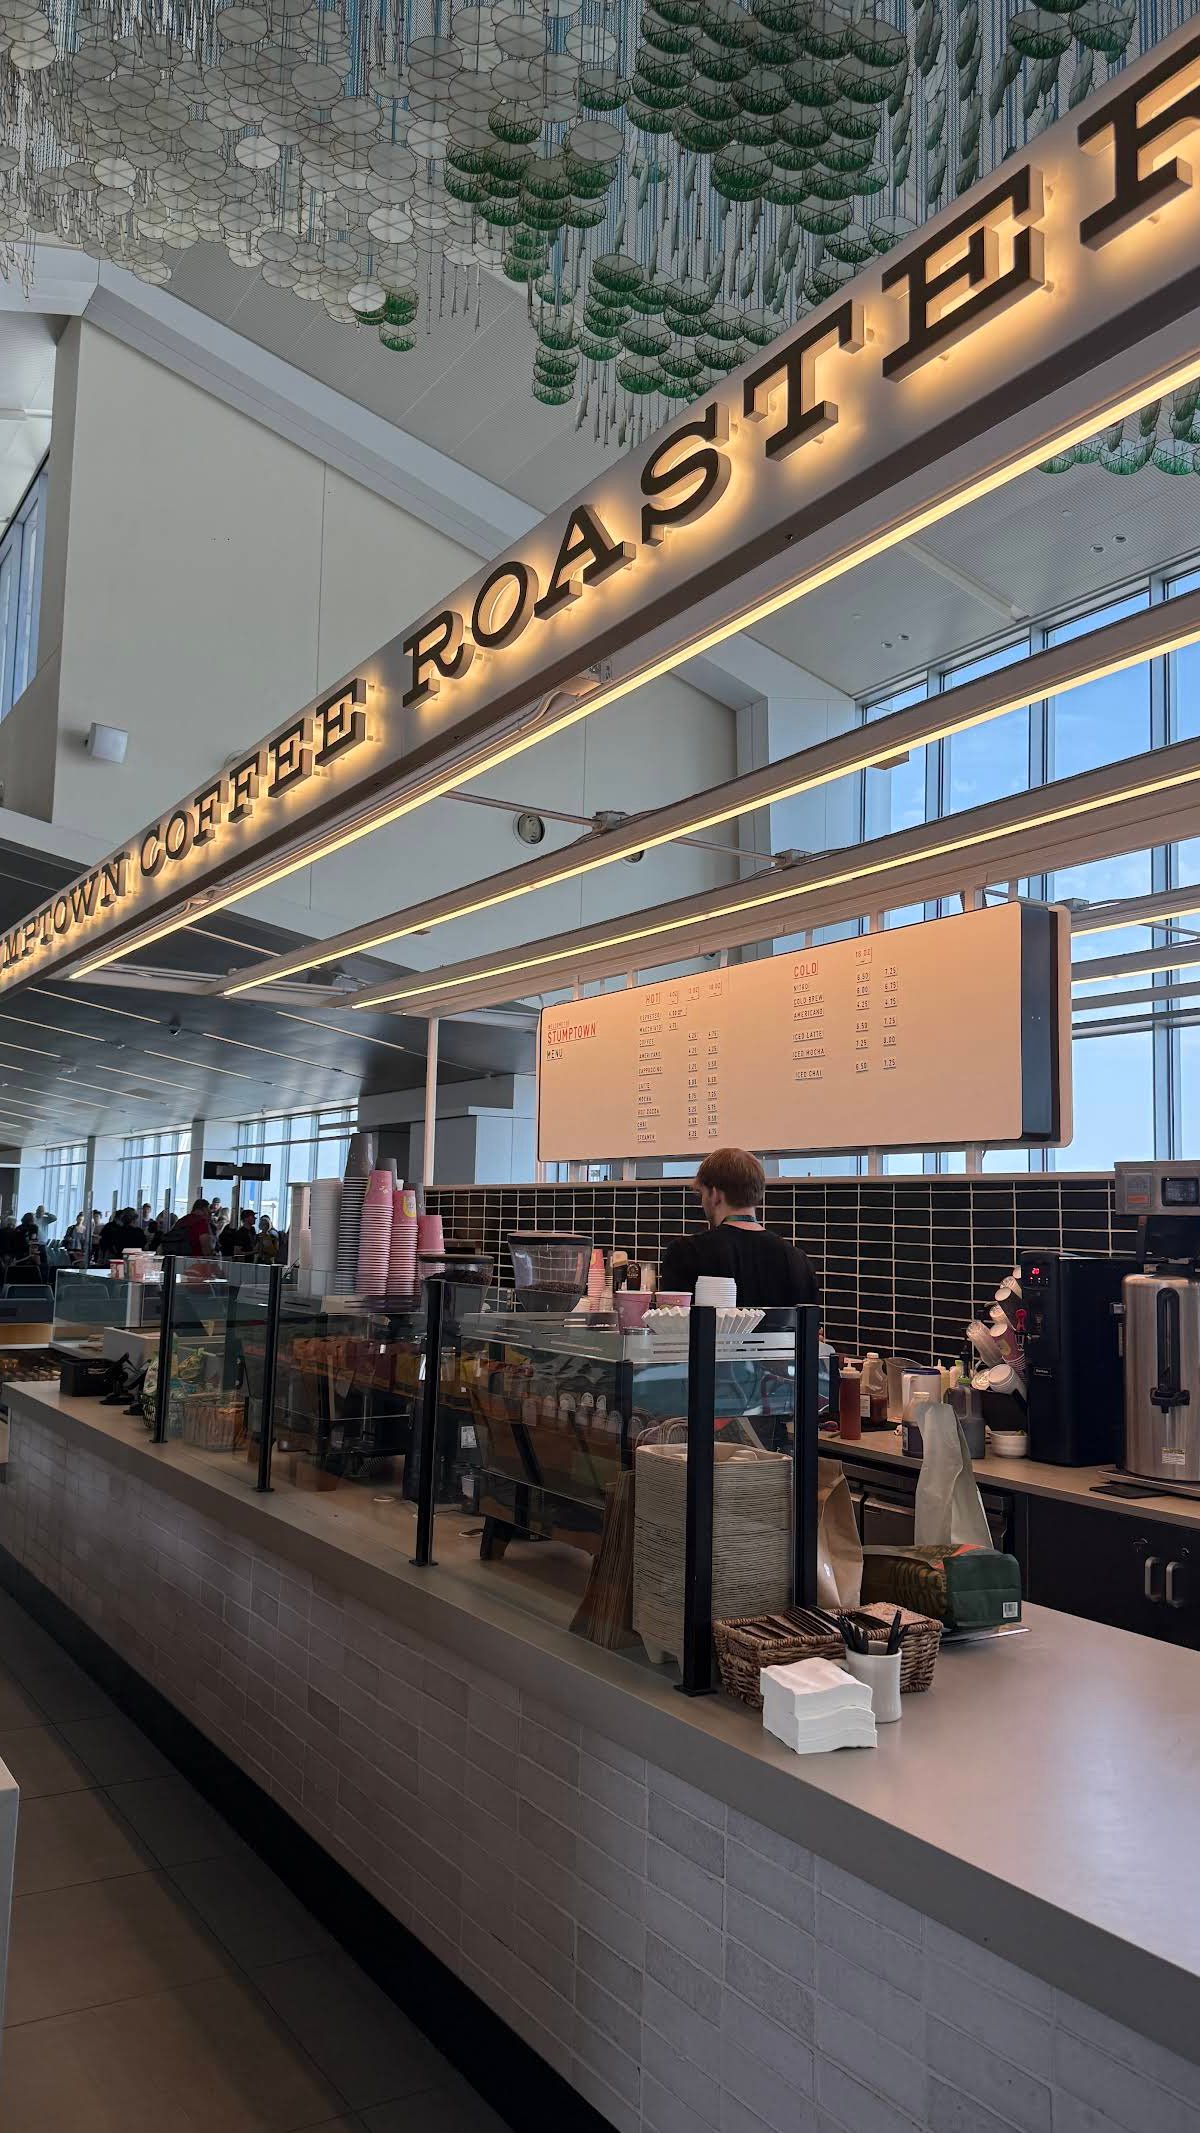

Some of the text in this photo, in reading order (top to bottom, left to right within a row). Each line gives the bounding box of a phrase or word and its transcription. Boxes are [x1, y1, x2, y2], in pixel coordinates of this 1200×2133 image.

[0, 851, 132, 974] MPTOWN
[139, 678, 367, 877] COFFEE
[794, 962, 817, 977] COLD
[793, 983, 809, 992] NITRO
[645, 992, 659, 1004] HOT
[793, 997, 807, 1006] COLD
[808, 995, 823, 1003] BREW
[793, 1008, 823, 1019] AMERICANO
[547, 1022, 596, 1044] STUMPTOWN
[792, 1032, 805, 1041] ICED
[806, 1030, 822, 1039] LATTE
[546, 1048, 563, 1059] MENU
[792, 1049, 804, 1058] ICED
[805, 1048, 825, 1057] MOCHA
[795, 1071, 807, 1079] ICED
[808, 1069, 822, 1077] CHAI
